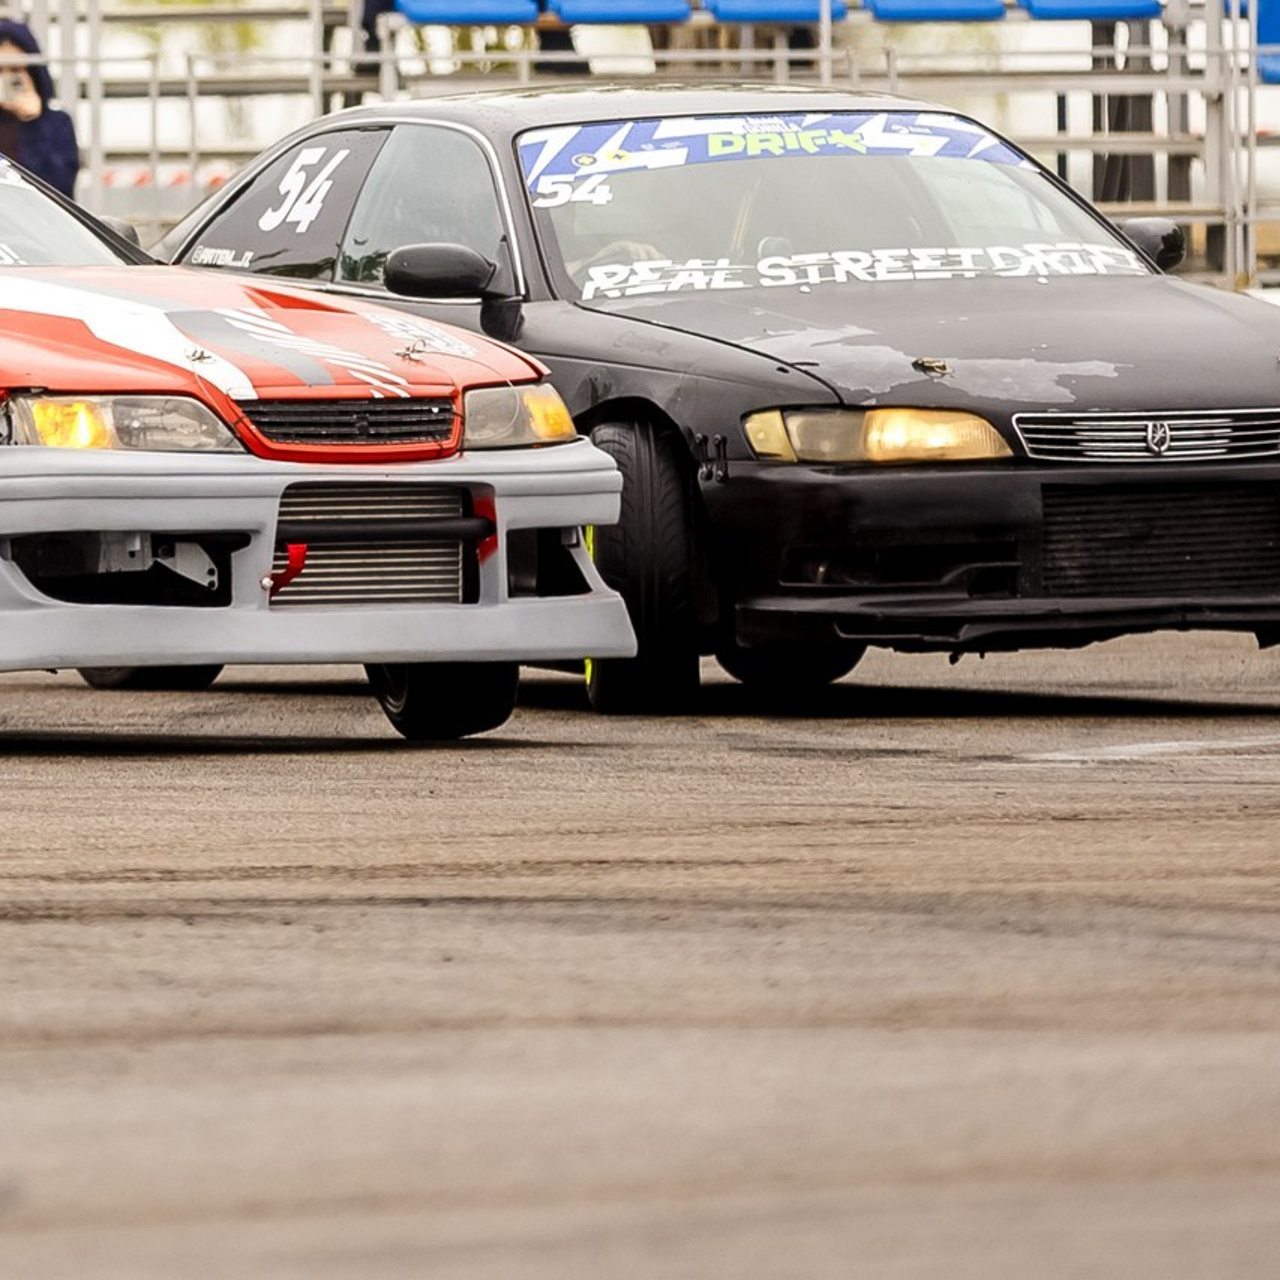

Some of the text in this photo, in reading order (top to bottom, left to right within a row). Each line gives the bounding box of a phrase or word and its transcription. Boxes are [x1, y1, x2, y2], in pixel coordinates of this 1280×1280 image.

[707, 129, 867, 156] DRIFT
[258, 146, 351, 233] 54
[532, 174, 613, 208] 54
[582, 258, 756, 300] REAL
[757, 249, 984, 287] STREET
